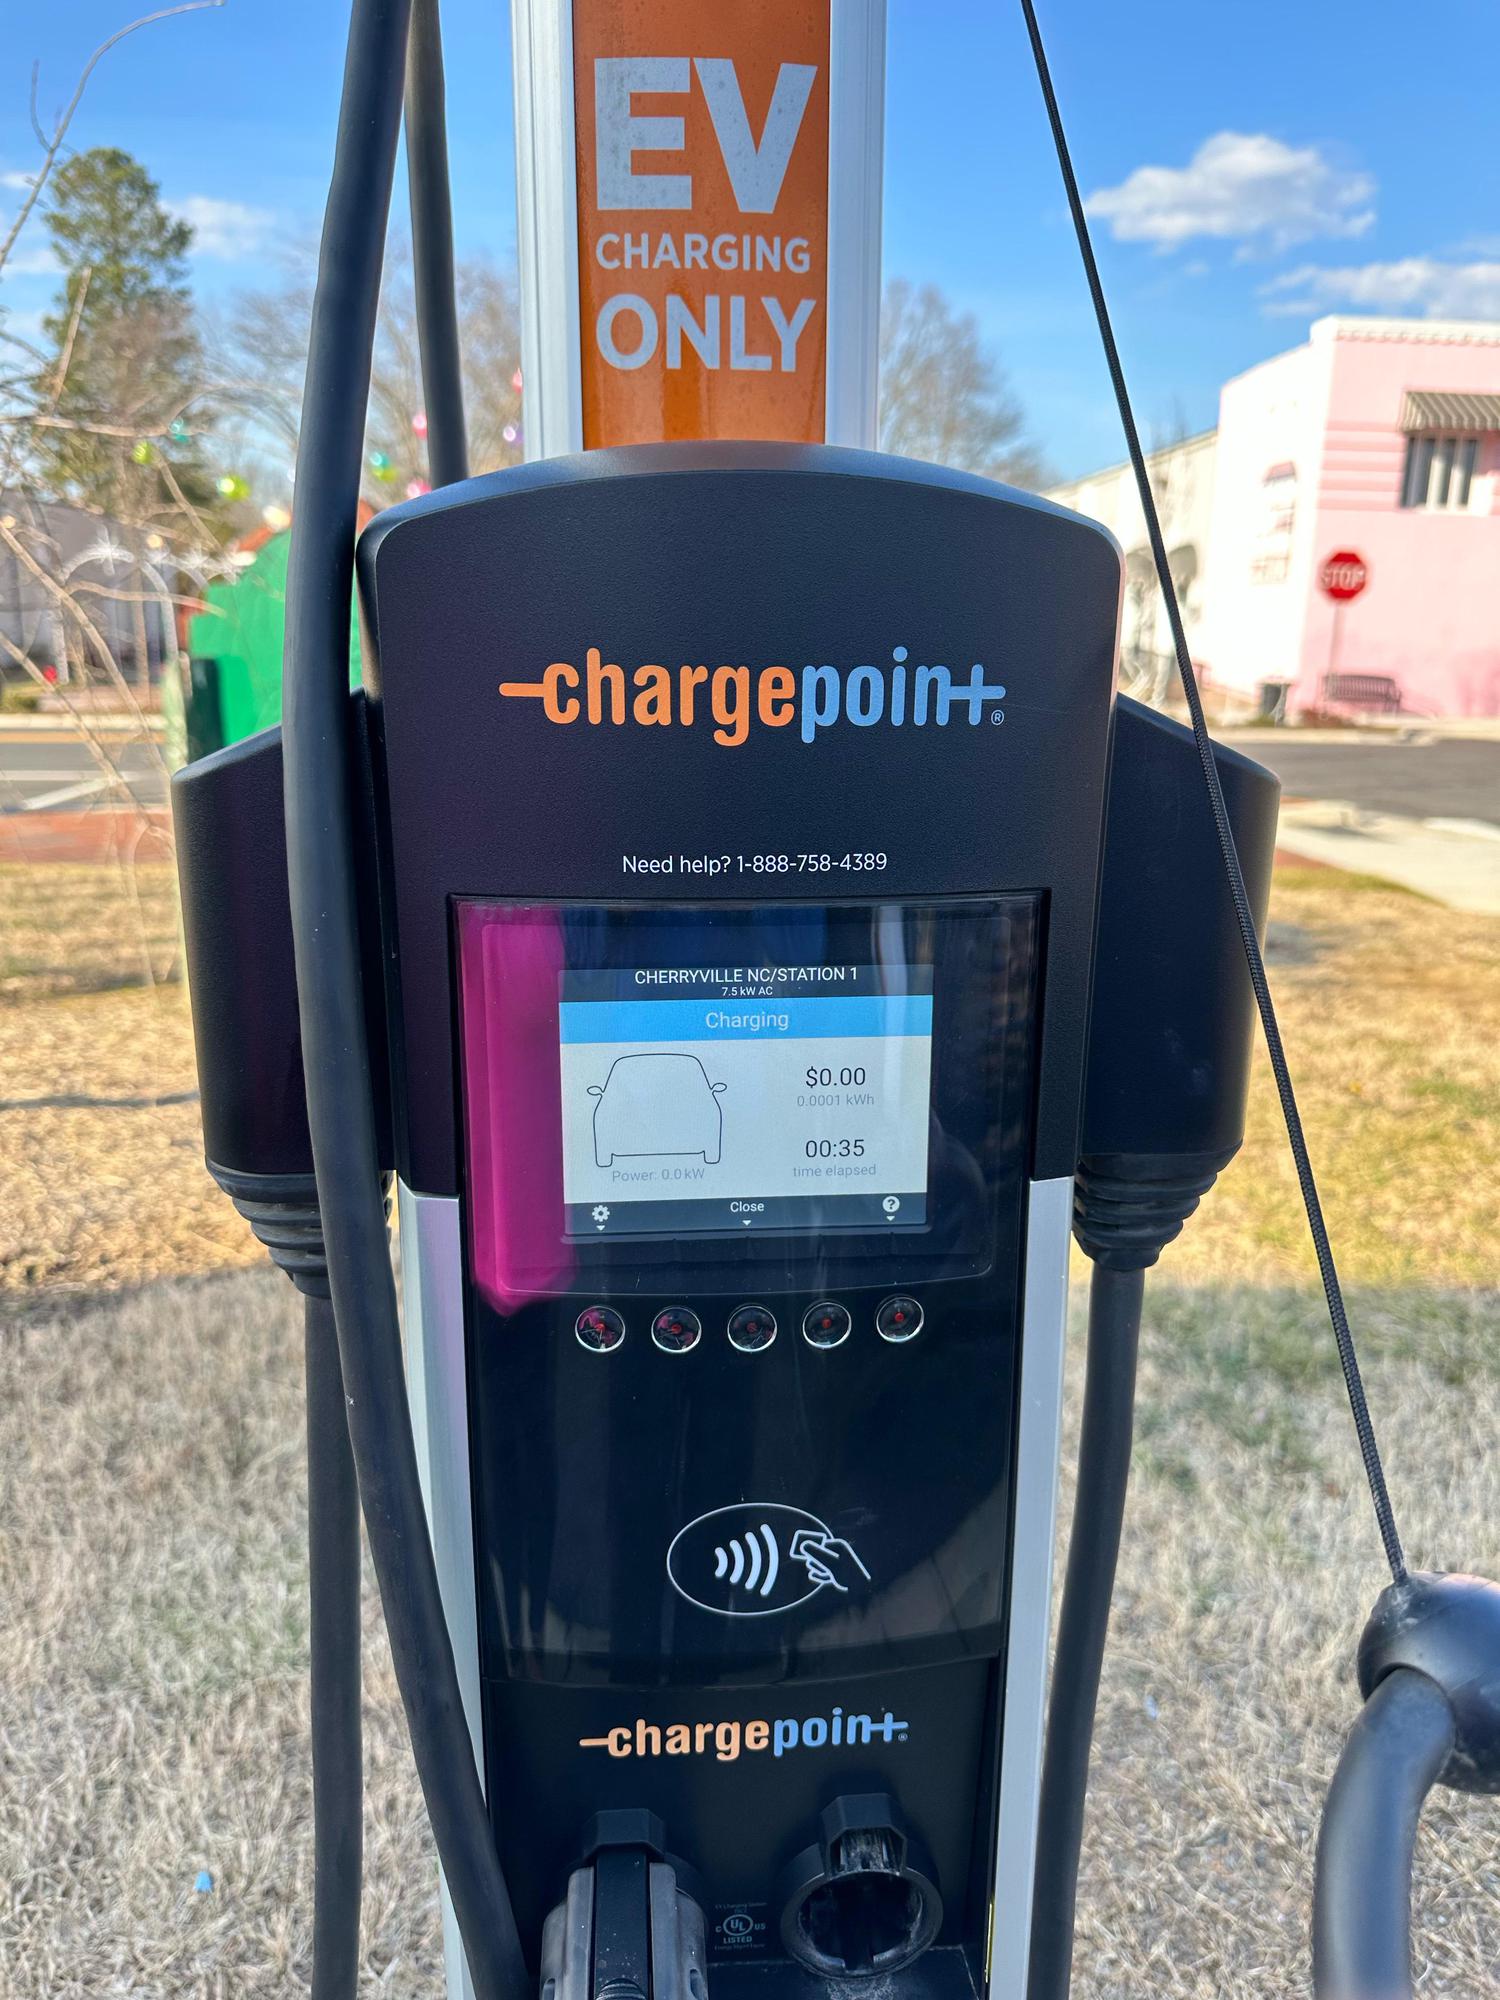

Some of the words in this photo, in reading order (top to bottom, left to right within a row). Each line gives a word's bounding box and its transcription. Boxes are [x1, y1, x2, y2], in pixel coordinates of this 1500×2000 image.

[594, 56, 818, 214] EV
[595, 232, 811, 274] CHARGING
[595, 294, 817, 373] ONLY
[1320, 565, 1365, 589] STOP
[622, 855, 673, 874] Need
[680, 855, 731, 877] help?
[737, 852, 888, 873] 1-888-758-4389
[634, 968, 743, 985] CHERRYVILLE
[747, 967, 845, 983] NC/STATION
[850, 967, 858, 980] 1
[721, 987, 738, 997] 7.5
[740, 986, 756, 996] kW
[758, 986, 773, 996] AC
[705, 1011, 790, 1032] Charging
[805, 1066, 866, 1089] $0.00
[796, 1095, 841, 1107] 0.0001
[846, 1093, 875, 1106] kWh
[805, 1139, 865, 1158] 00:35
[611, 1170, 656, 1182] Power:
[661, 1169, 683, 1181] 0.0
[685, 1168, 705, 1180] kW
[793, 1166, 822, 1177] time
[825, 1164, 877, 1178] elapsed
[730, 1201, 765, 1213] Close
[723, 1936, 753, 1944] LISTED
